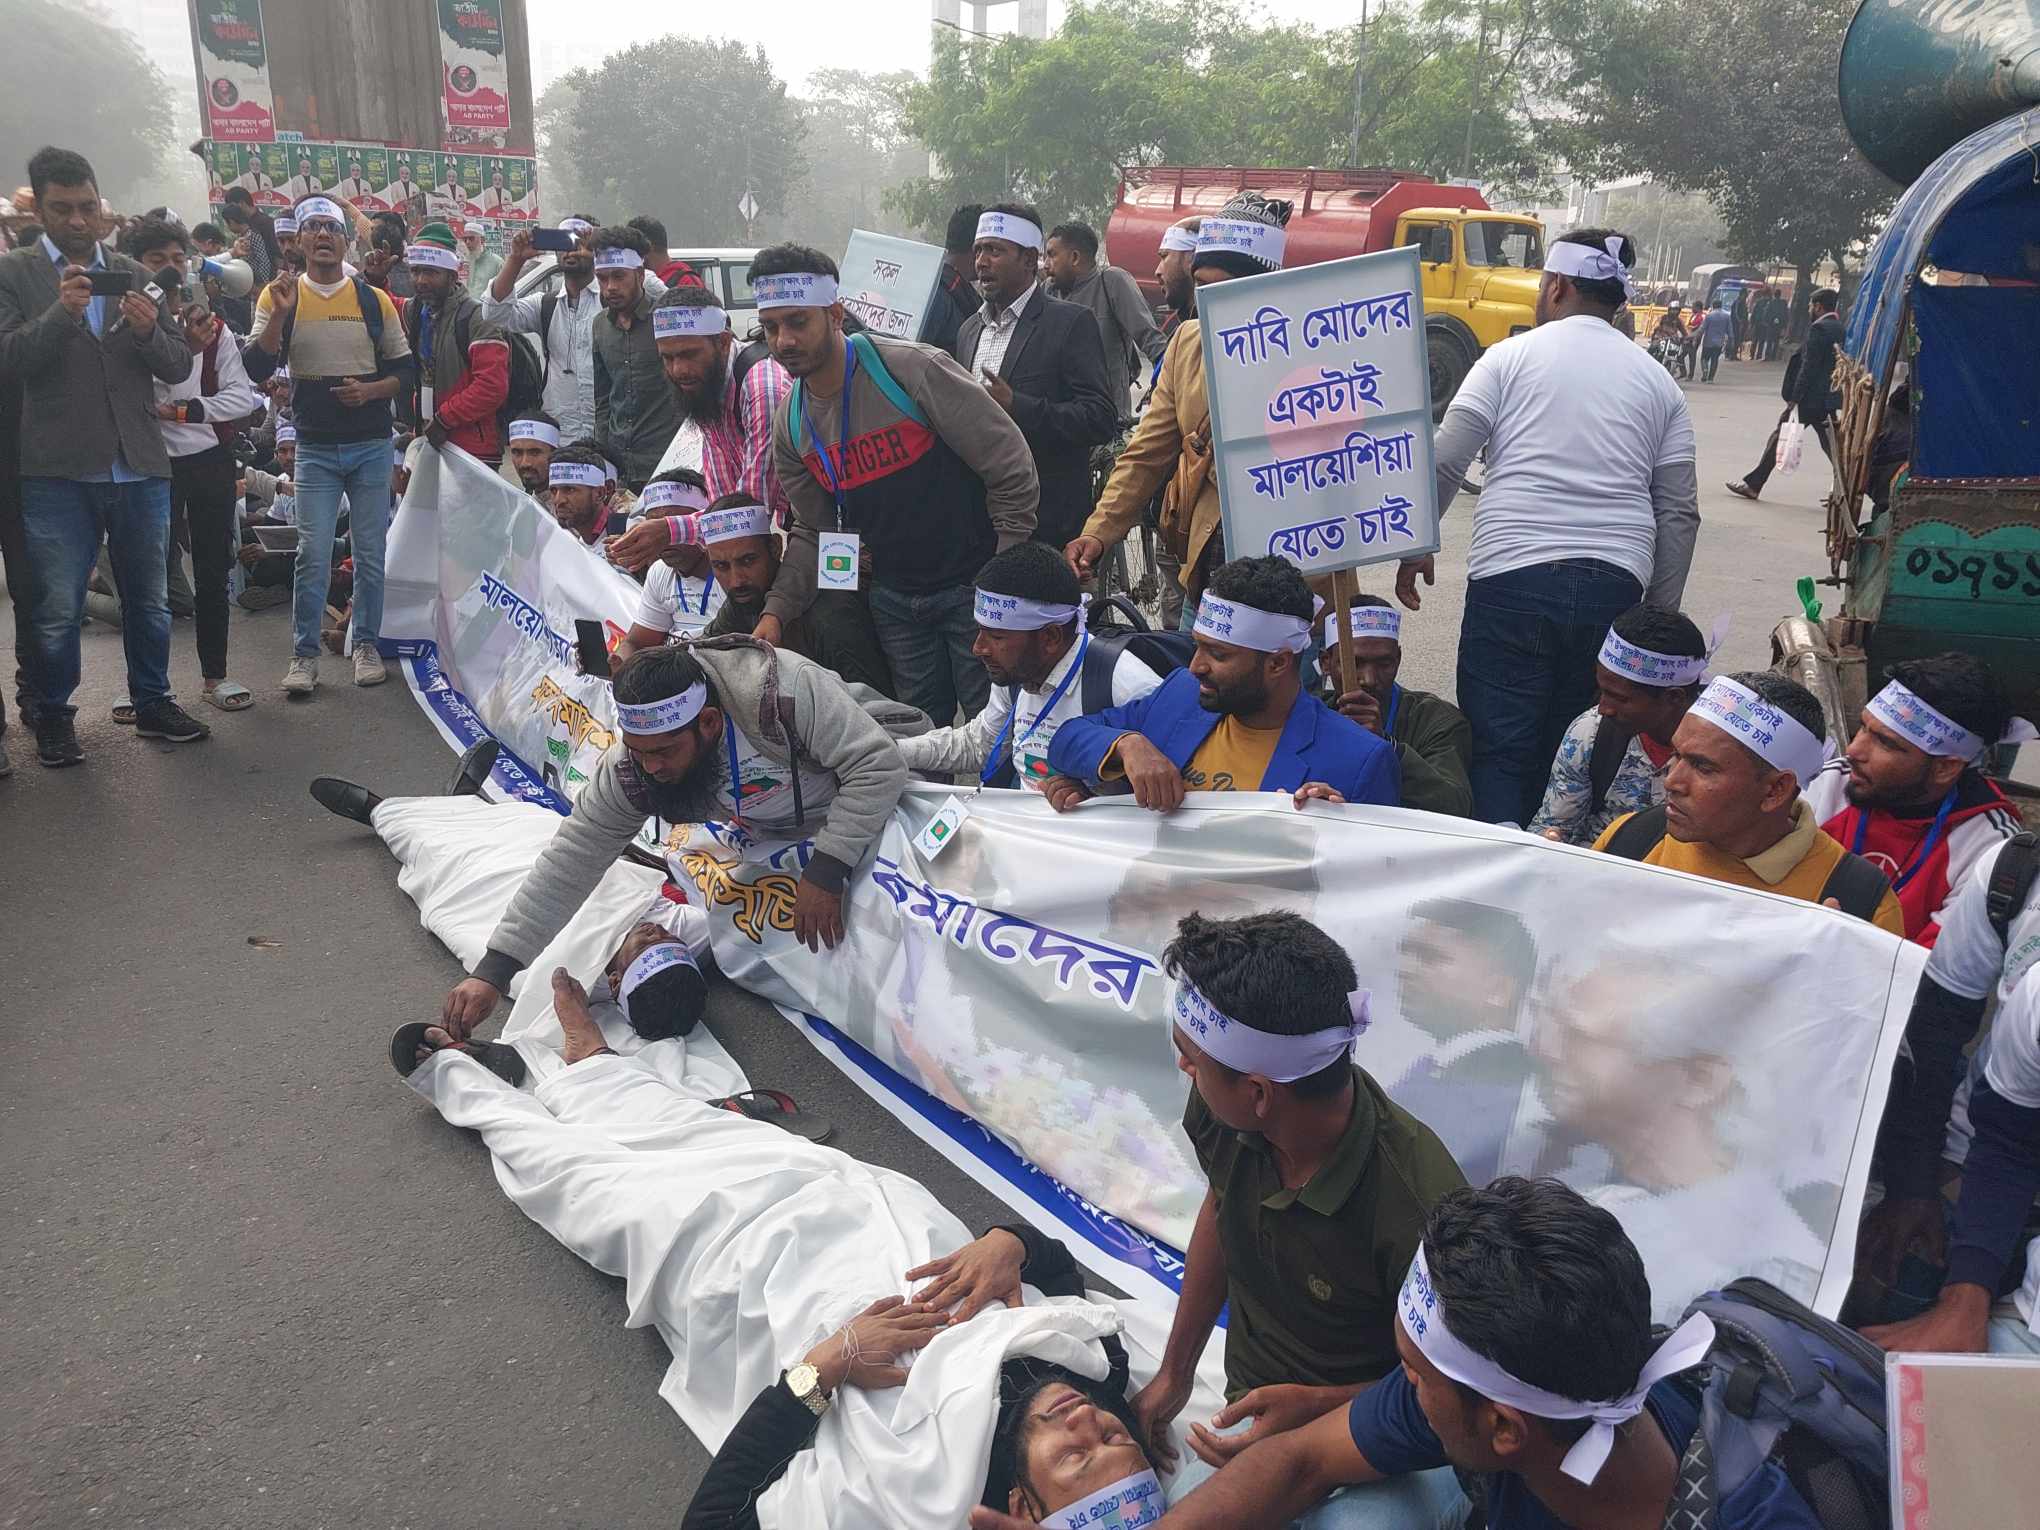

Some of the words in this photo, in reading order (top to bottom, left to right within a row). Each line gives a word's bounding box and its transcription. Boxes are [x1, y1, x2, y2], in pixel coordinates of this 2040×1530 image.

[235, 127, 260, 136] PARTY
[800, 276, 814, 286] চাই
[872, 258, 903, 288] সকল
[886, 308, 914, 338] জন্য
[1217, 306, 1291, 365] দাবি
[1302, 289, 1414, 350] মোদের
[1268, 361, 1385, 426] একটাই
[1246, 430, 1416, 501] মালয়েশিয়া
[1268, 516, 1347, 562] যেতে
[1355, 494, 1416, 548] চাই
[989, 610, 1004, 622] চাই
[1002, 599, 1018, 611] চাই
[1215, 621, 1233, 637] চাই
[674, 696, 690, 709] চাই
[1744, 700, 1784, 731] একটাই
[666, 711, 682, 724] চাই
[1724, 711, 1754, 733] যেতে
[1751, 727, 1775, 752] চাই
[1189, 1014, 1210, 1041] চাই
[1208, 1006, 1231, 1033] চাই
[1408, 1305, 1428, 1342] চাই
[1066, 1511, 1088, 1530] চাই
[1090, 1495, 1121, 1521] যেতে
